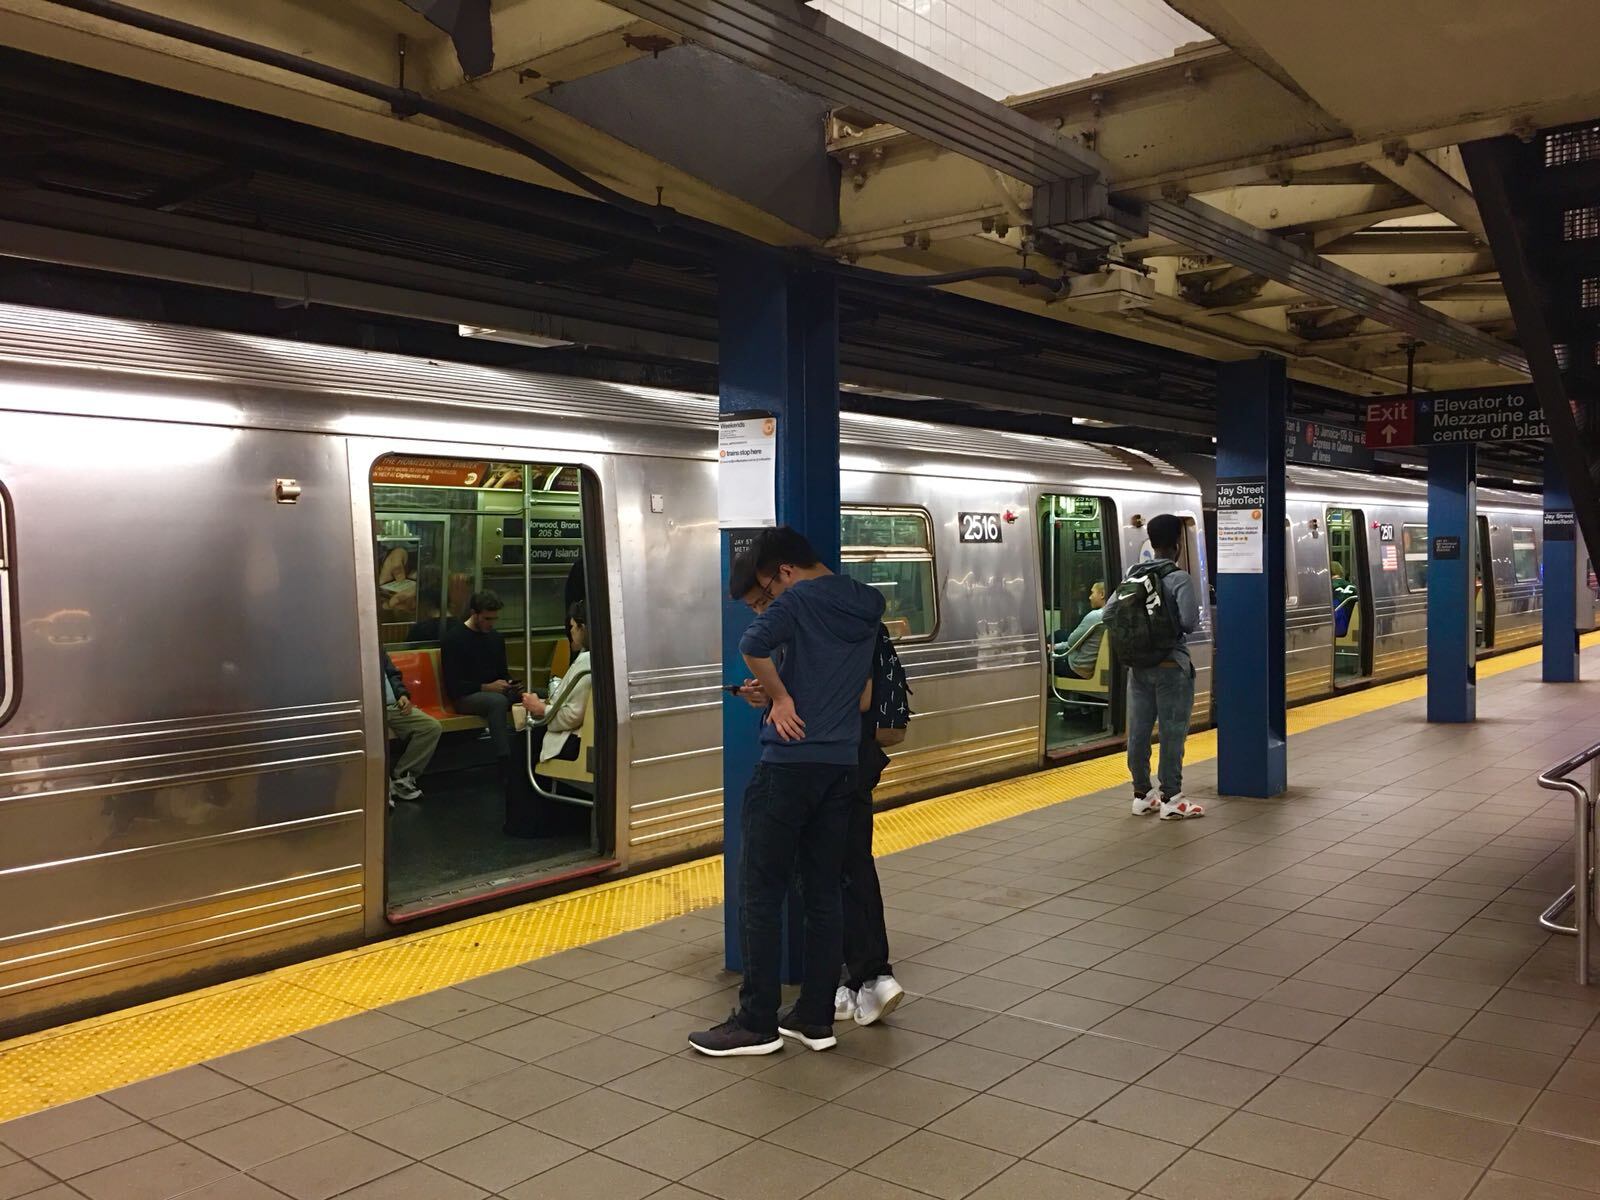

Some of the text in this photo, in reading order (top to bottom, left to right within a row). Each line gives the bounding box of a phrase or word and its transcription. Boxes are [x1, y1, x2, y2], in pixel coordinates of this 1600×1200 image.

[1434, 394, 1524, 412] Elevator to
[1367, 402, 1408, 422] Exit
[1433, 407, 1546, 427] Mezzanine at
[1432, 426, 1486, 441] center
[1490, 424, 1508, 438] of
[1218, 485, 1264, 496] Jay Street
[1217, 496, 1265, 505] MetroTech
[529, 520, 579, 529] orwood, Bronx
[963, 514, 998, 540] 2516
[538, 529, 561, 537] 205 St
[530, 548, 579, 560] oney Island
